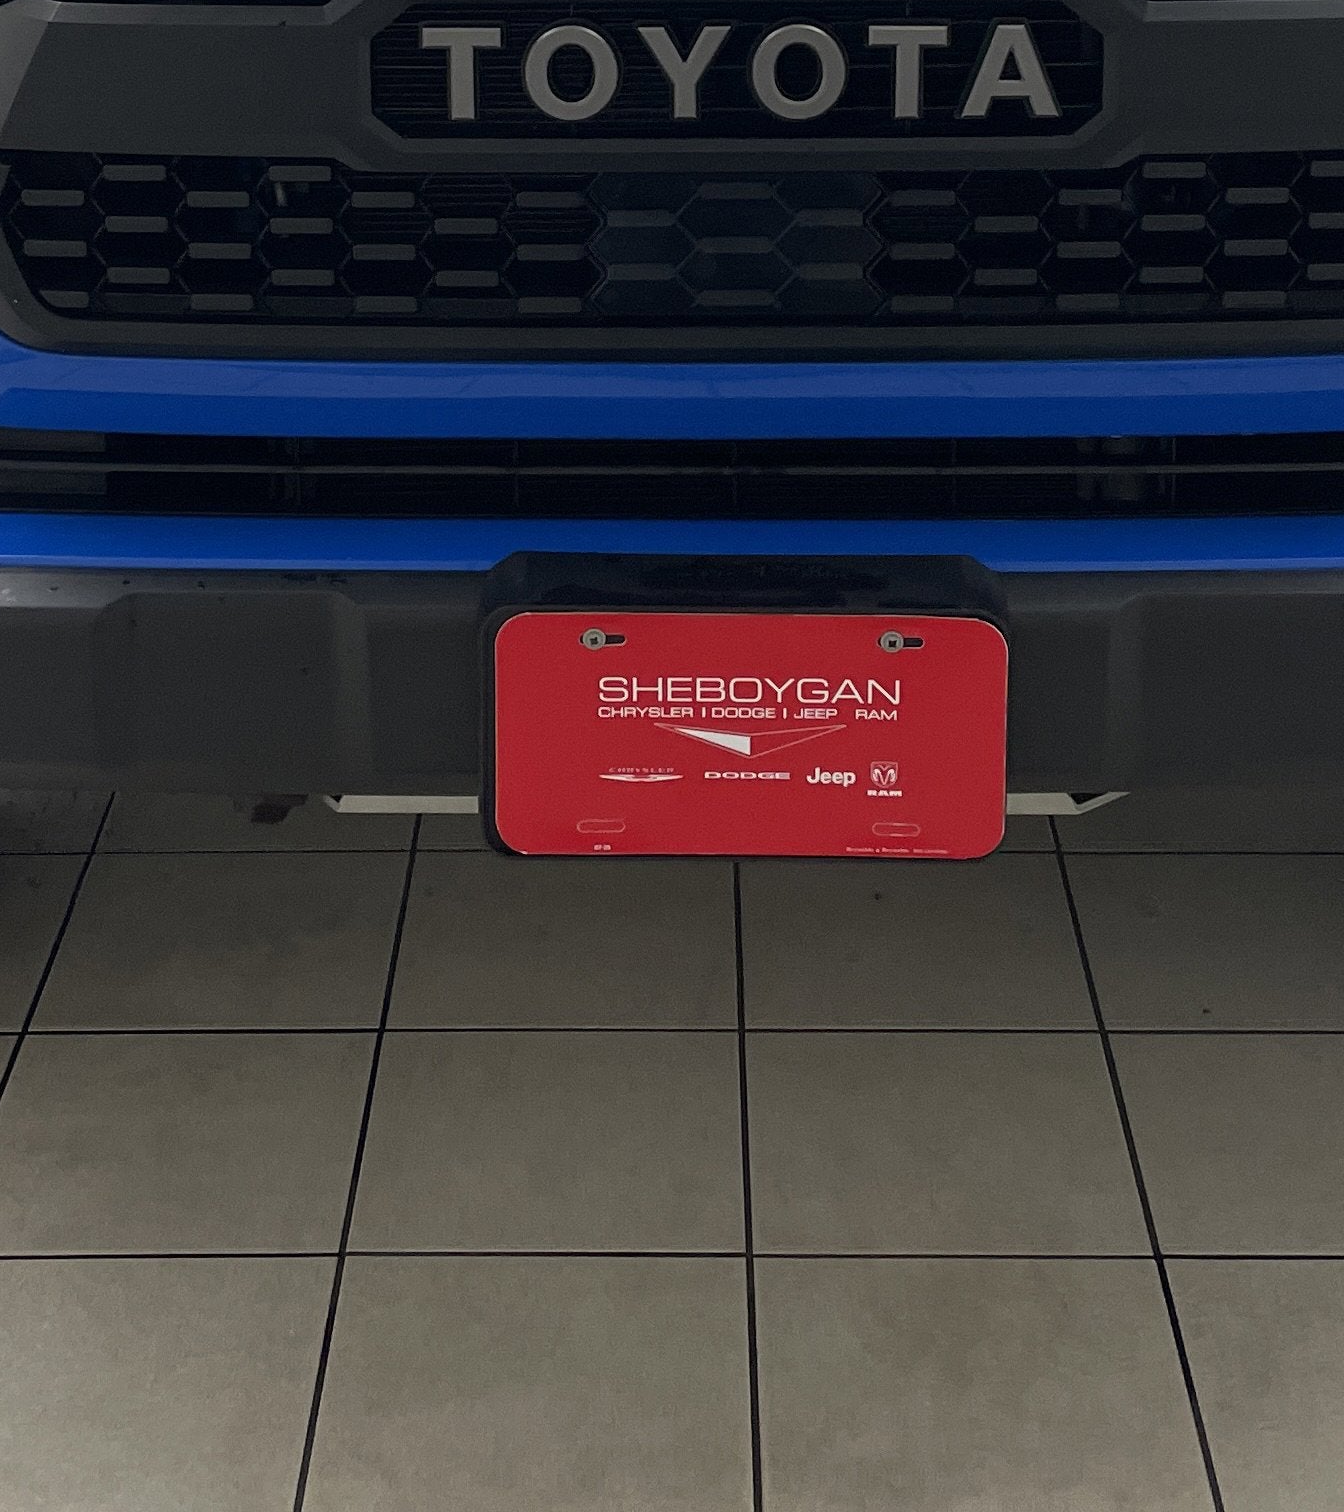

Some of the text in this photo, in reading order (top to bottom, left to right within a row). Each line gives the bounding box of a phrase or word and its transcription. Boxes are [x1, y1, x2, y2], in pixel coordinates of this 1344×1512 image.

[421, 24, 1060, 121] TOYOTA
[598, 676, 901, 705] SHEBOYGAN
[597, 706, 694, 719] CHRYSLER
[711, 707, 777, 719] DODGE
[794, 708, 838, 720] JEEP
[855, 709, 898, 721] RAM
[704, 771, 791, 780] DODGE
[806, 766, 856, 787] Jeep
[867, 789, 903, 797] RAM
